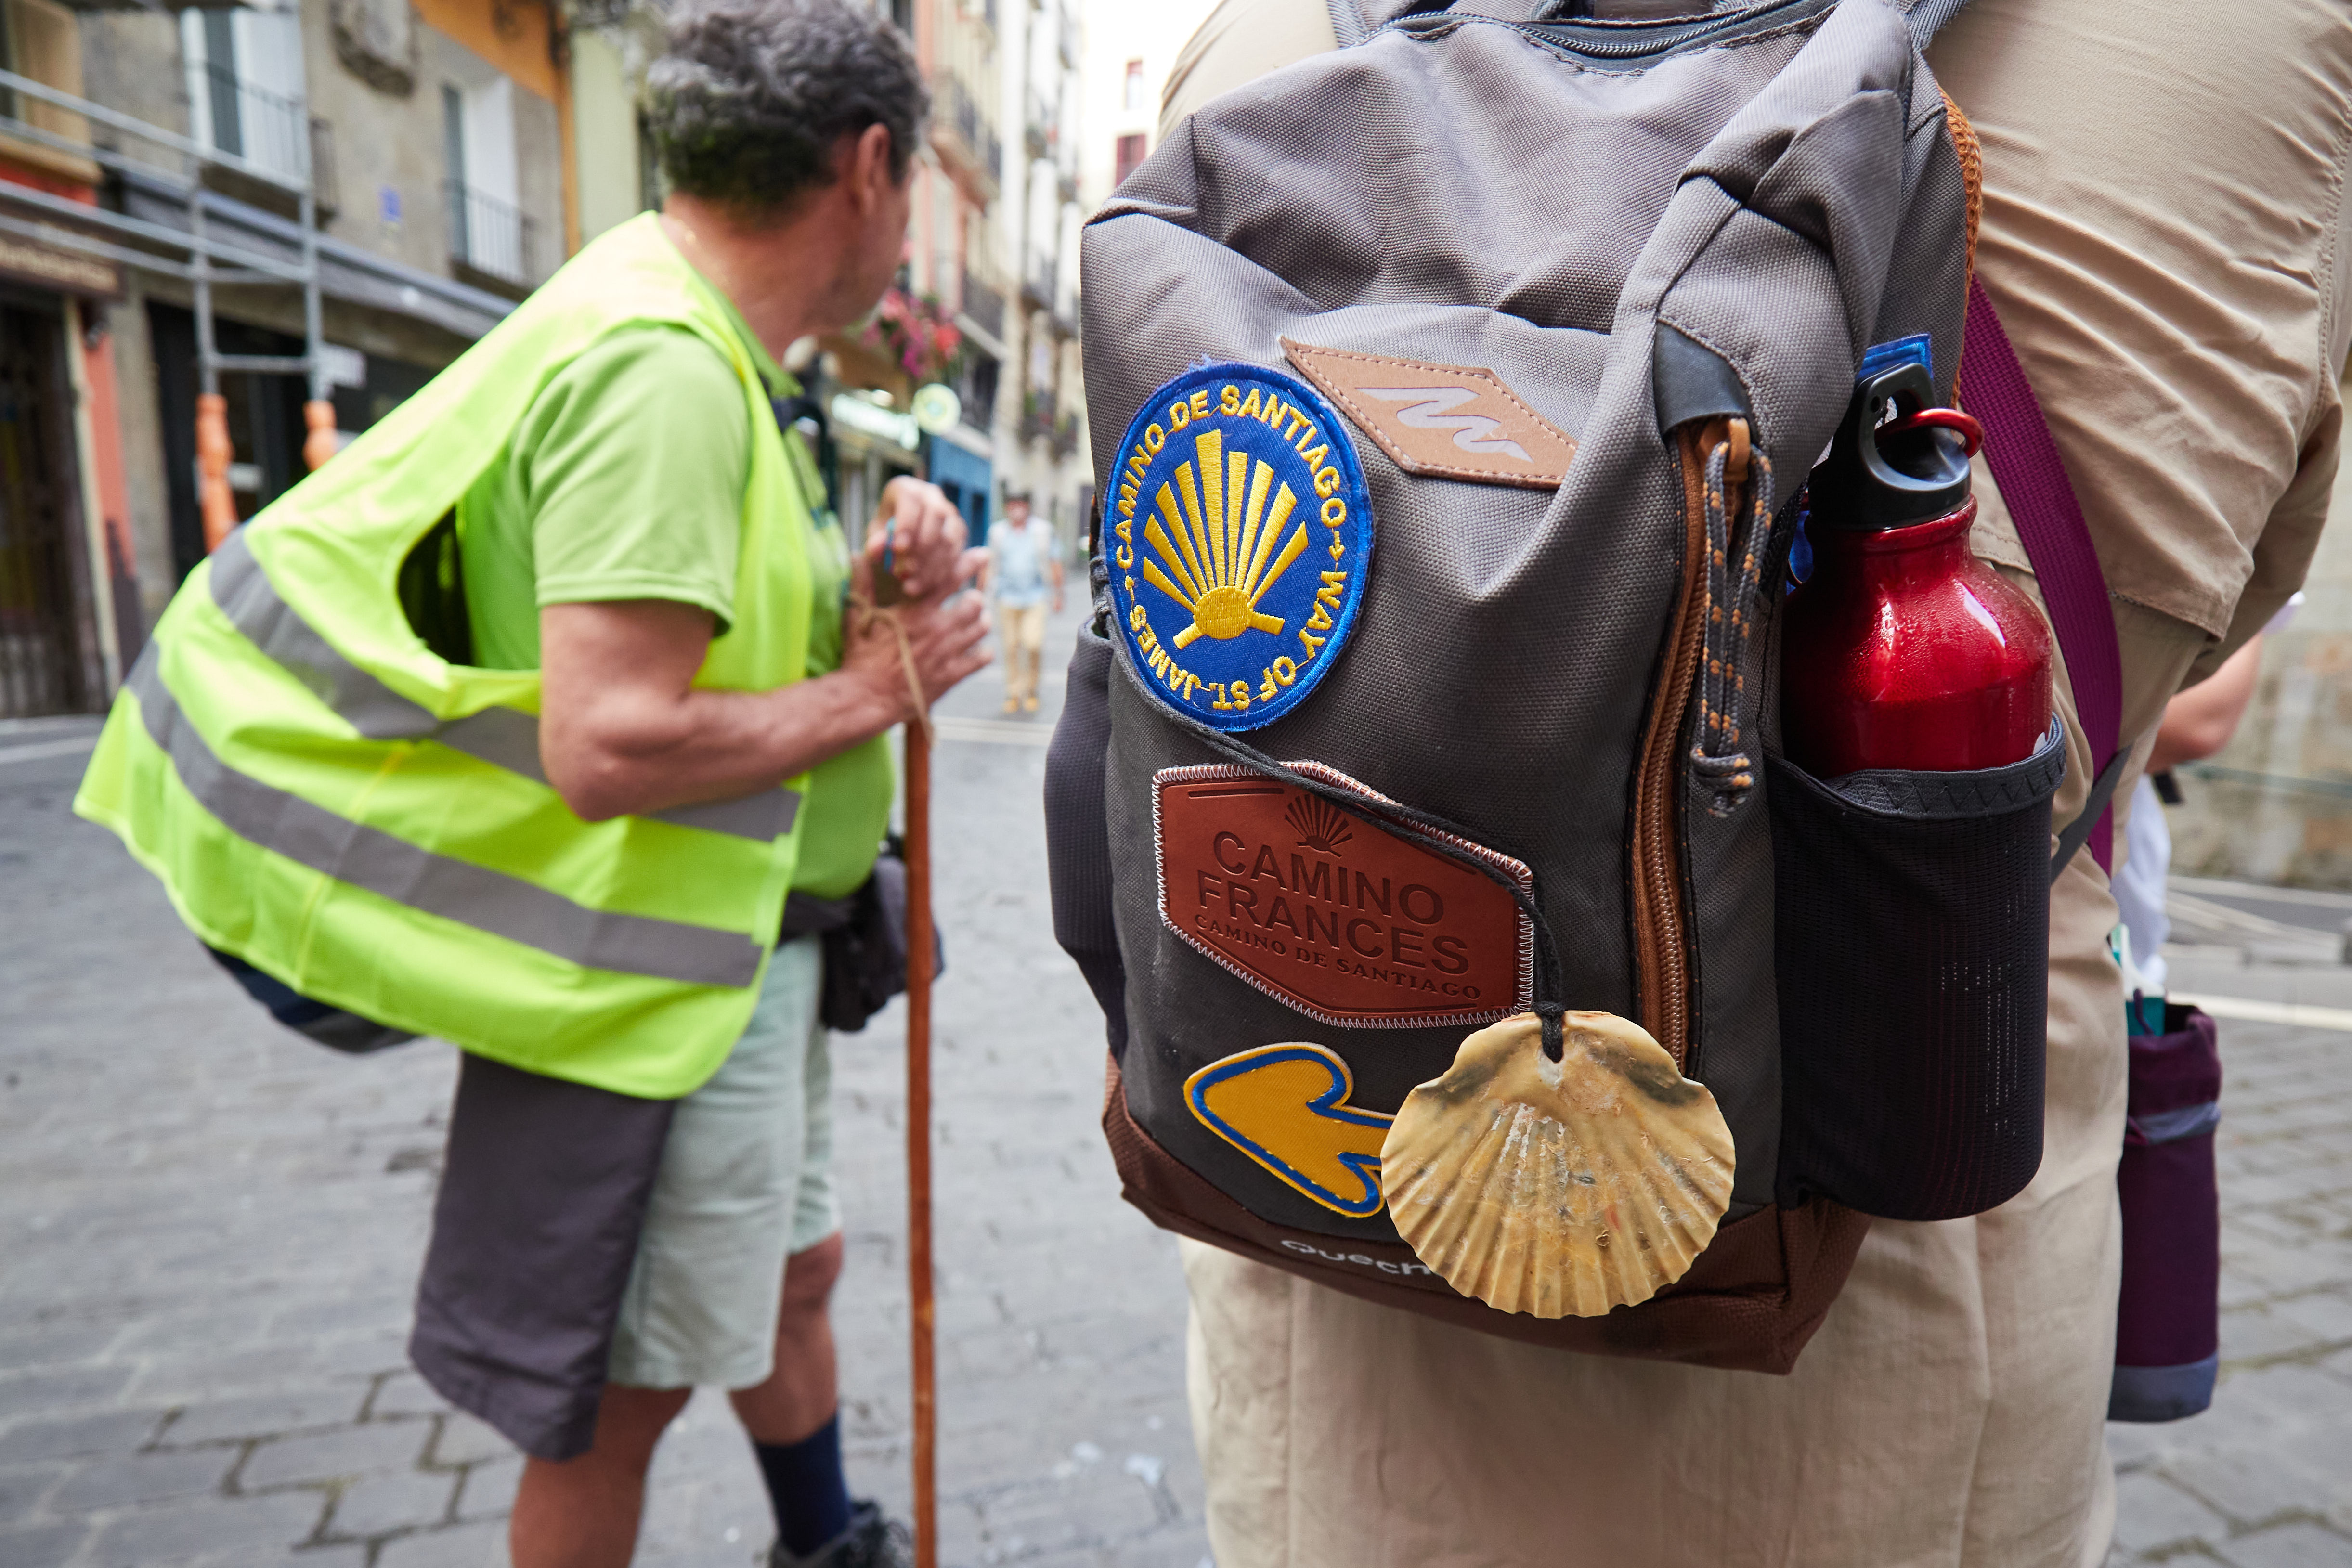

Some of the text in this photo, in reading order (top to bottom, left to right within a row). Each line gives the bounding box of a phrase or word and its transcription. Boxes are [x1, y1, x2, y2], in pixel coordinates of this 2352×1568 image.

[1115, 385, 1347, 567] CAMINO DE SANTIAGO
[1130, 604, 1202, 700] JAMES
[1299, 570, 1347, 661] WAY
[1260, 655, 1297, 702] OF
[1197, 869, 1470, 975] FRANCES
[1213, 830, 1444, 925] CAMINO
[1194, 914, 1481, 1000] CAMINO DE SANTIAGO
[1281, 1239, 1432, 1275] Quech
